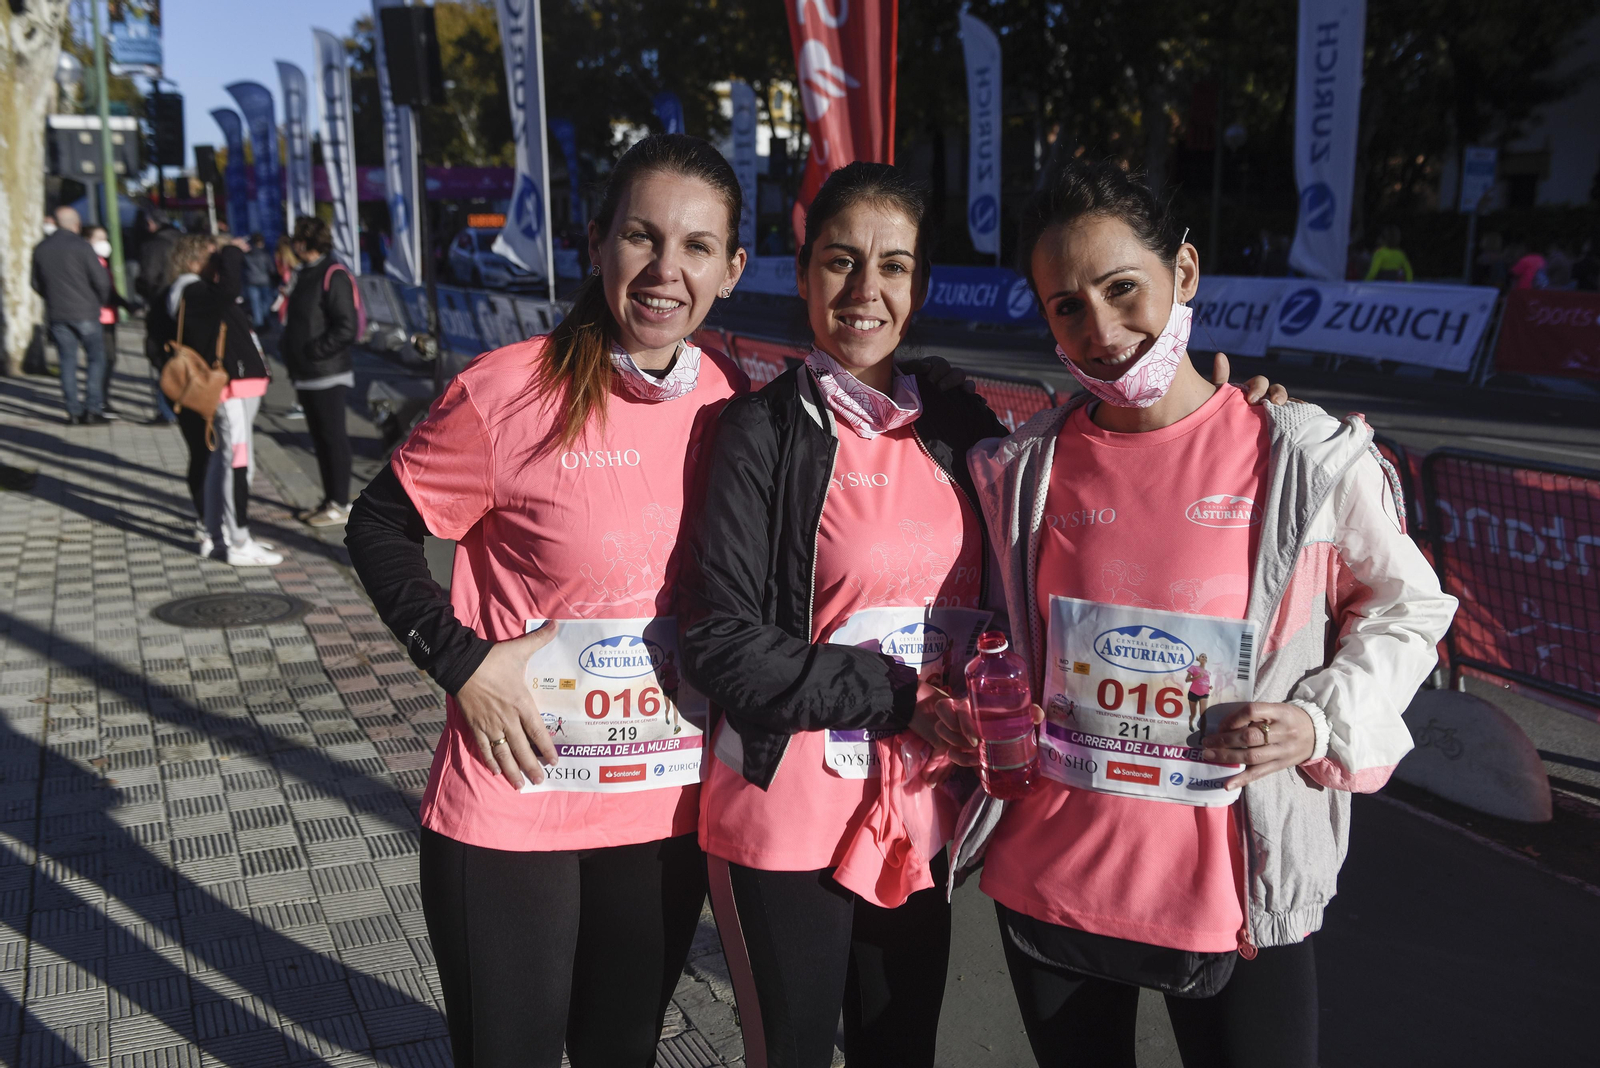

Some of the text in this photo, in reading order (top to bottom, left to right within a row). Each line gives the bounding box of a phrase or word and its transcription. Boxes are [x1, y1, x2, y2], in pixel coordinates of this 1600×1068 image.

[933, 281, 1000, 308] ZURICH
[1194, 301, 1270, 332] RICH
[1526, 299, 1594, 327] Sports
[1323, 300, 1470, 346] ZURICH
[560, 448, 641, 470] OYSHO
[830, 471, 889, 491] YSHO
[1191, 505, 1258, 521] ASTURIANA
[955, 566, 981, 585] PO
[407, 629, 431, 655] WEDZE
[1100, 637, 1187, 666] ASTURIANA
[1116, 637, 1184, 652] CENTRAL LECHERA
[584, 651, 660, 668] ASTURIANA
[584, 686, 661, 719] 016
[1096, 678, 1184, 719] 016
[1122, 715, 1149, 723] VIOLENCIA
[607, 726, 638, 742] 219
[1118, 721, 1150, 740] 211
[560, 739, 681, 756] CARRERA DE LA MUJER
[1070, 732, 1122, 751] CARRERA
[1124, 741, 1142, 754] DE
[1144, 744, 1160, 757] LA
[667, 761, 699, 773] ZURICH
[1048, 747, 1098, 774] OYSHO
[543, 767, 591, 781] YSHO
[613, 770, 641, 778] Santander
[1121, 768, 1154, 780] Santander
